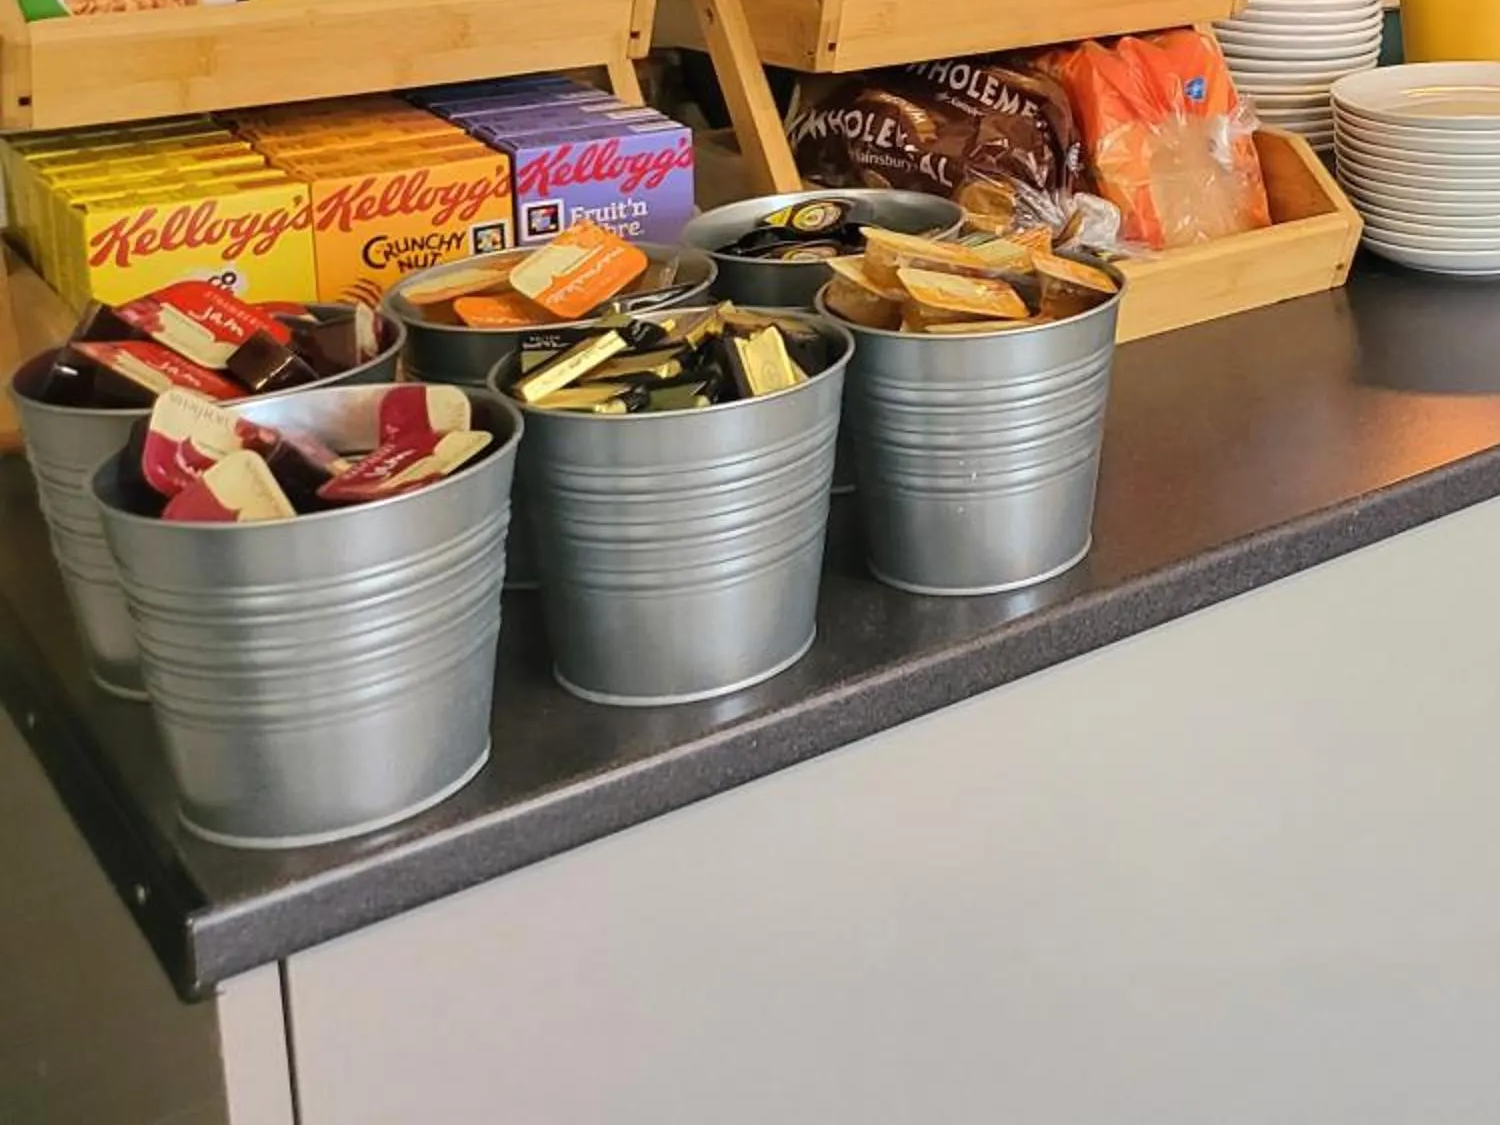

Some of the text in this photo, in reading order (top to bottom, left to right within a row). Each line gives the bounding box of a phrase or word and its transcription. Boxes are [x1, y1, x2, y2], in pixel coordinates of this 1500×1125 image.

[518, 137, 694, 196] Kellogg's
[314, 165, 512, 232] Kellogg's
[570, 197, 648, 226] Fruit'n
[89, 195, 313, 268] Kellogg's
[362, 231, 466, 269] CRUNCHY
[397, 253, 443, 273] NUT
